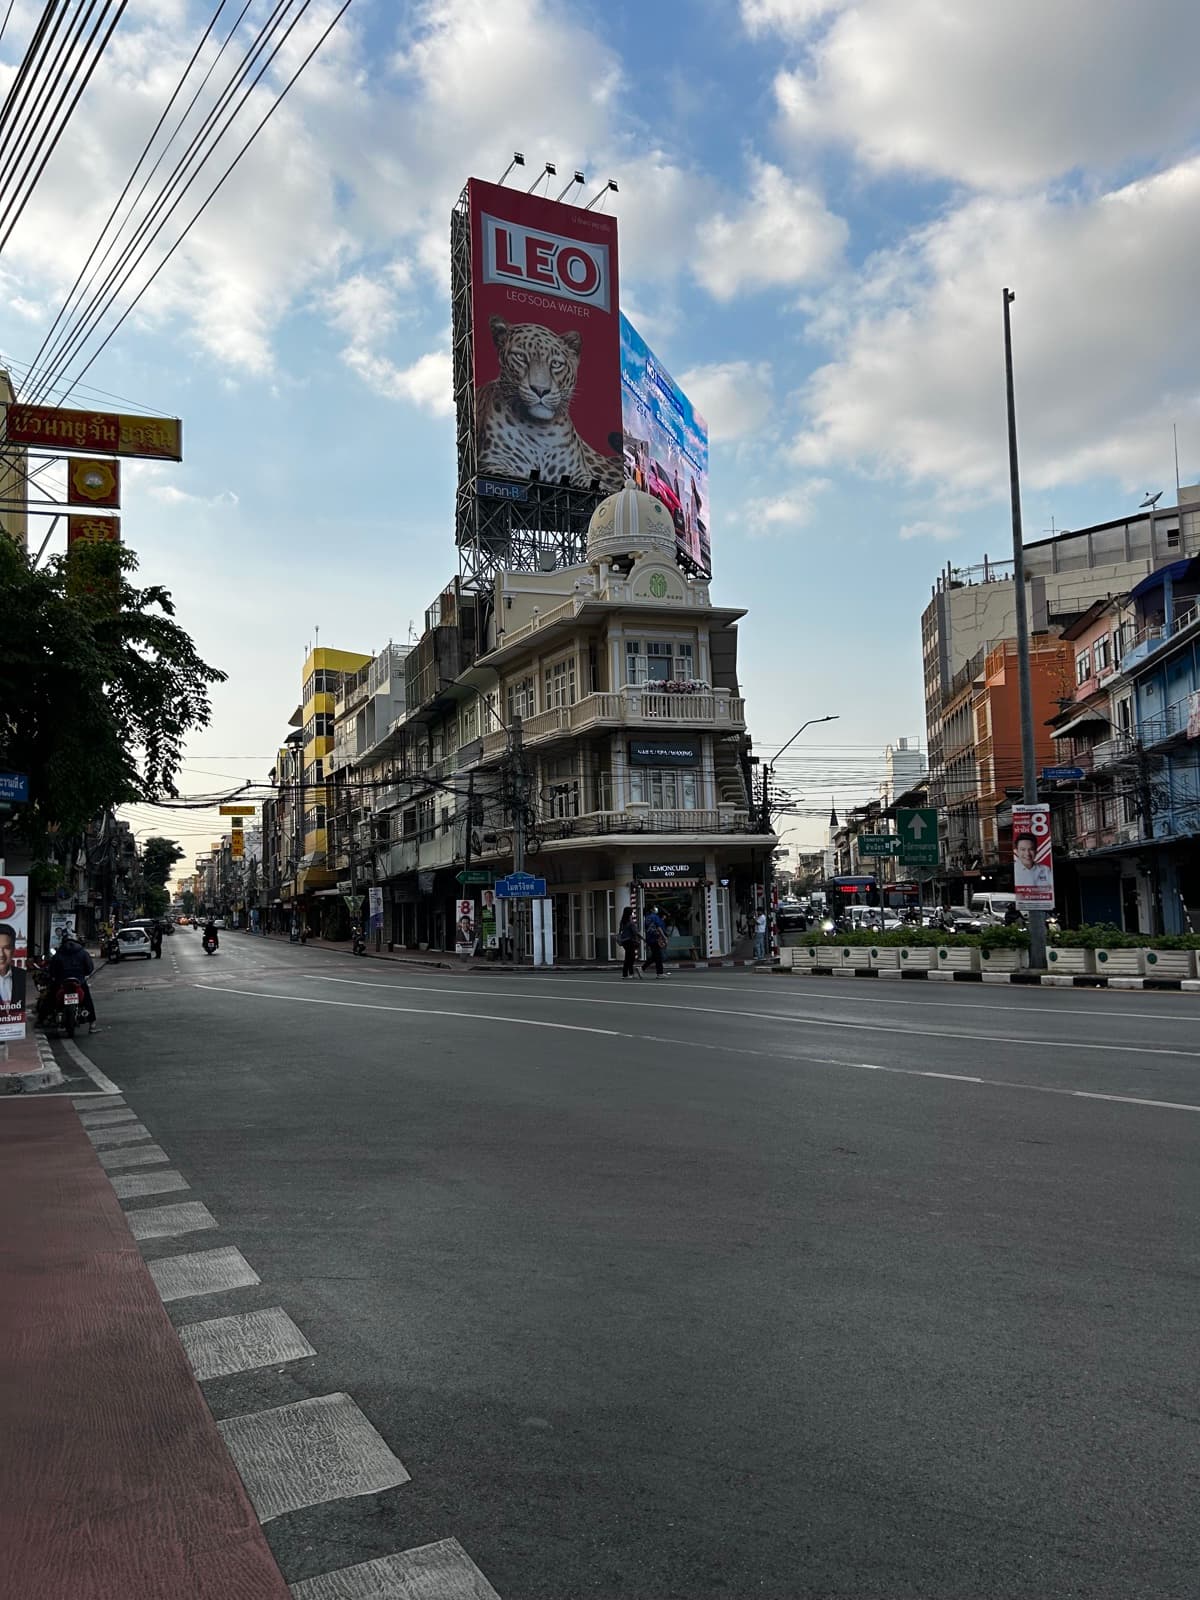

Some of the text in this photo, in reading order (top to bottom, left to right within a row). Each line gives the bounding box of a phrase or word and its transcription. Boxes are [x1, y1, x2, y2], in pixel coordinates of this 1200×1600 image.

[494, 227, 600, 297] LEO
[506, 289, 590, 318] LEO SODA WATER
[485, 482, 509, 497] Plan
[1031, 812, 1048, 836] 8
[461, 901, 471, 915] 8
[490, 938, 497, 946] 4
